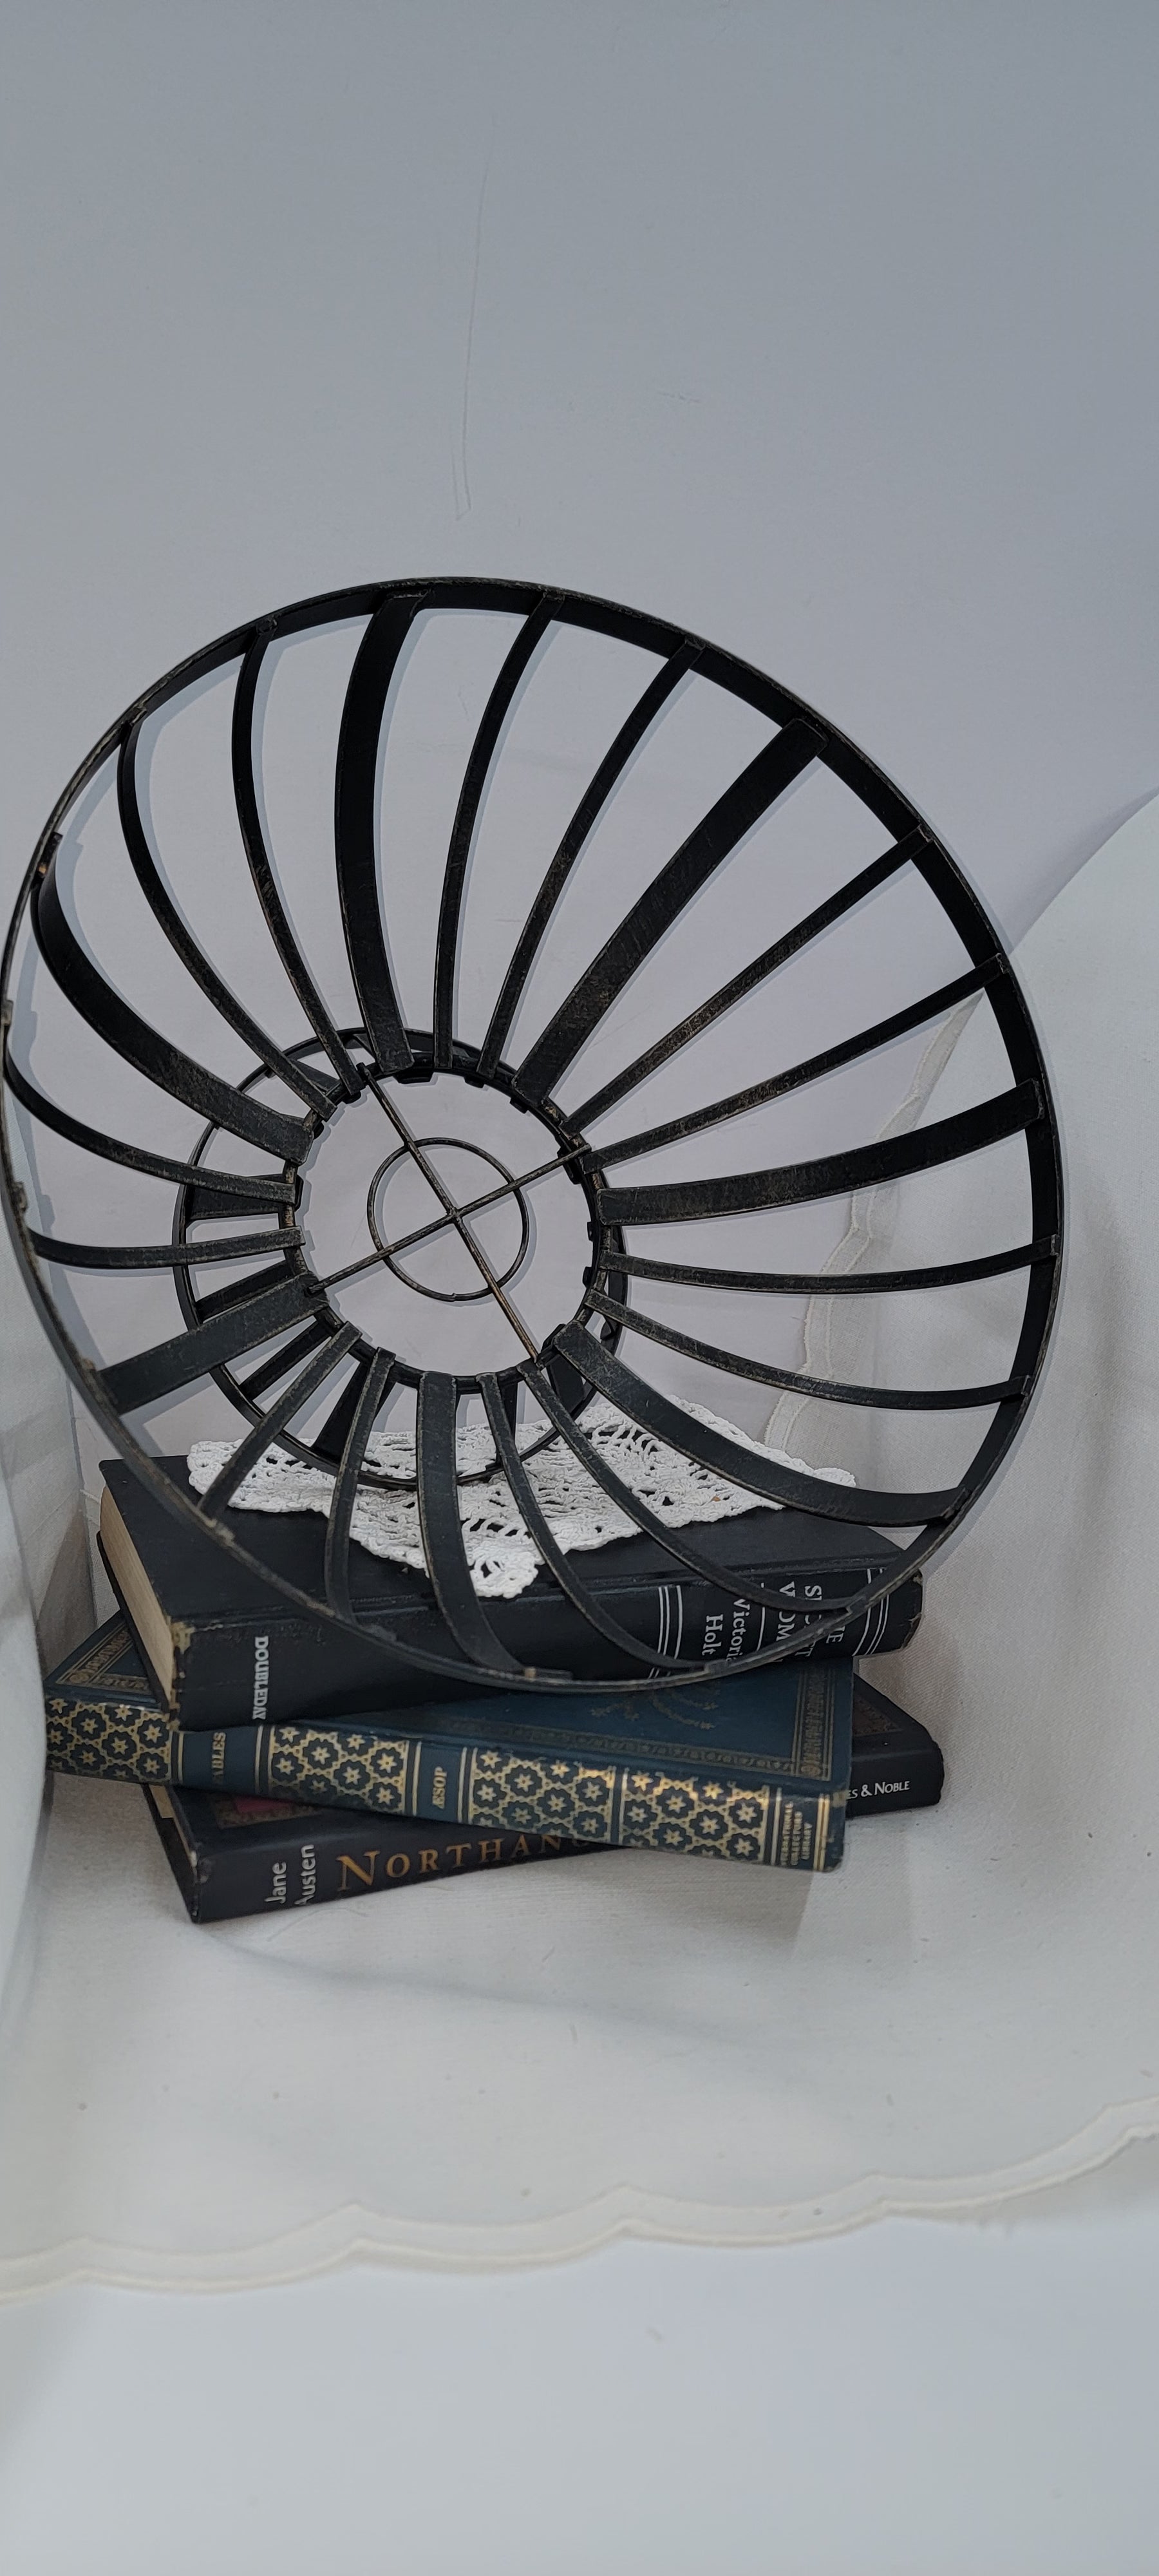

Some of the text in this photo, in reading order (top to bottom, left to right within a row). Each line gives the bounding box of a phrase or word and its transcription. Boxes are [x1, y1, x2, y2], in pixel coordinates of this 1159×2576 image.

[701, 1614, 724, 1656] Holt
[252, 1635, 269, 1720] DOUBLEDAY
[211, 1732, 226, 1783] ABLES
[860, 1784, 873, 1797] &
[264, 1861, 287, 1904] Jane
[294, 1844, 316, 1905] Austen
[335, 1833, 588, 1891] NORTHAN
